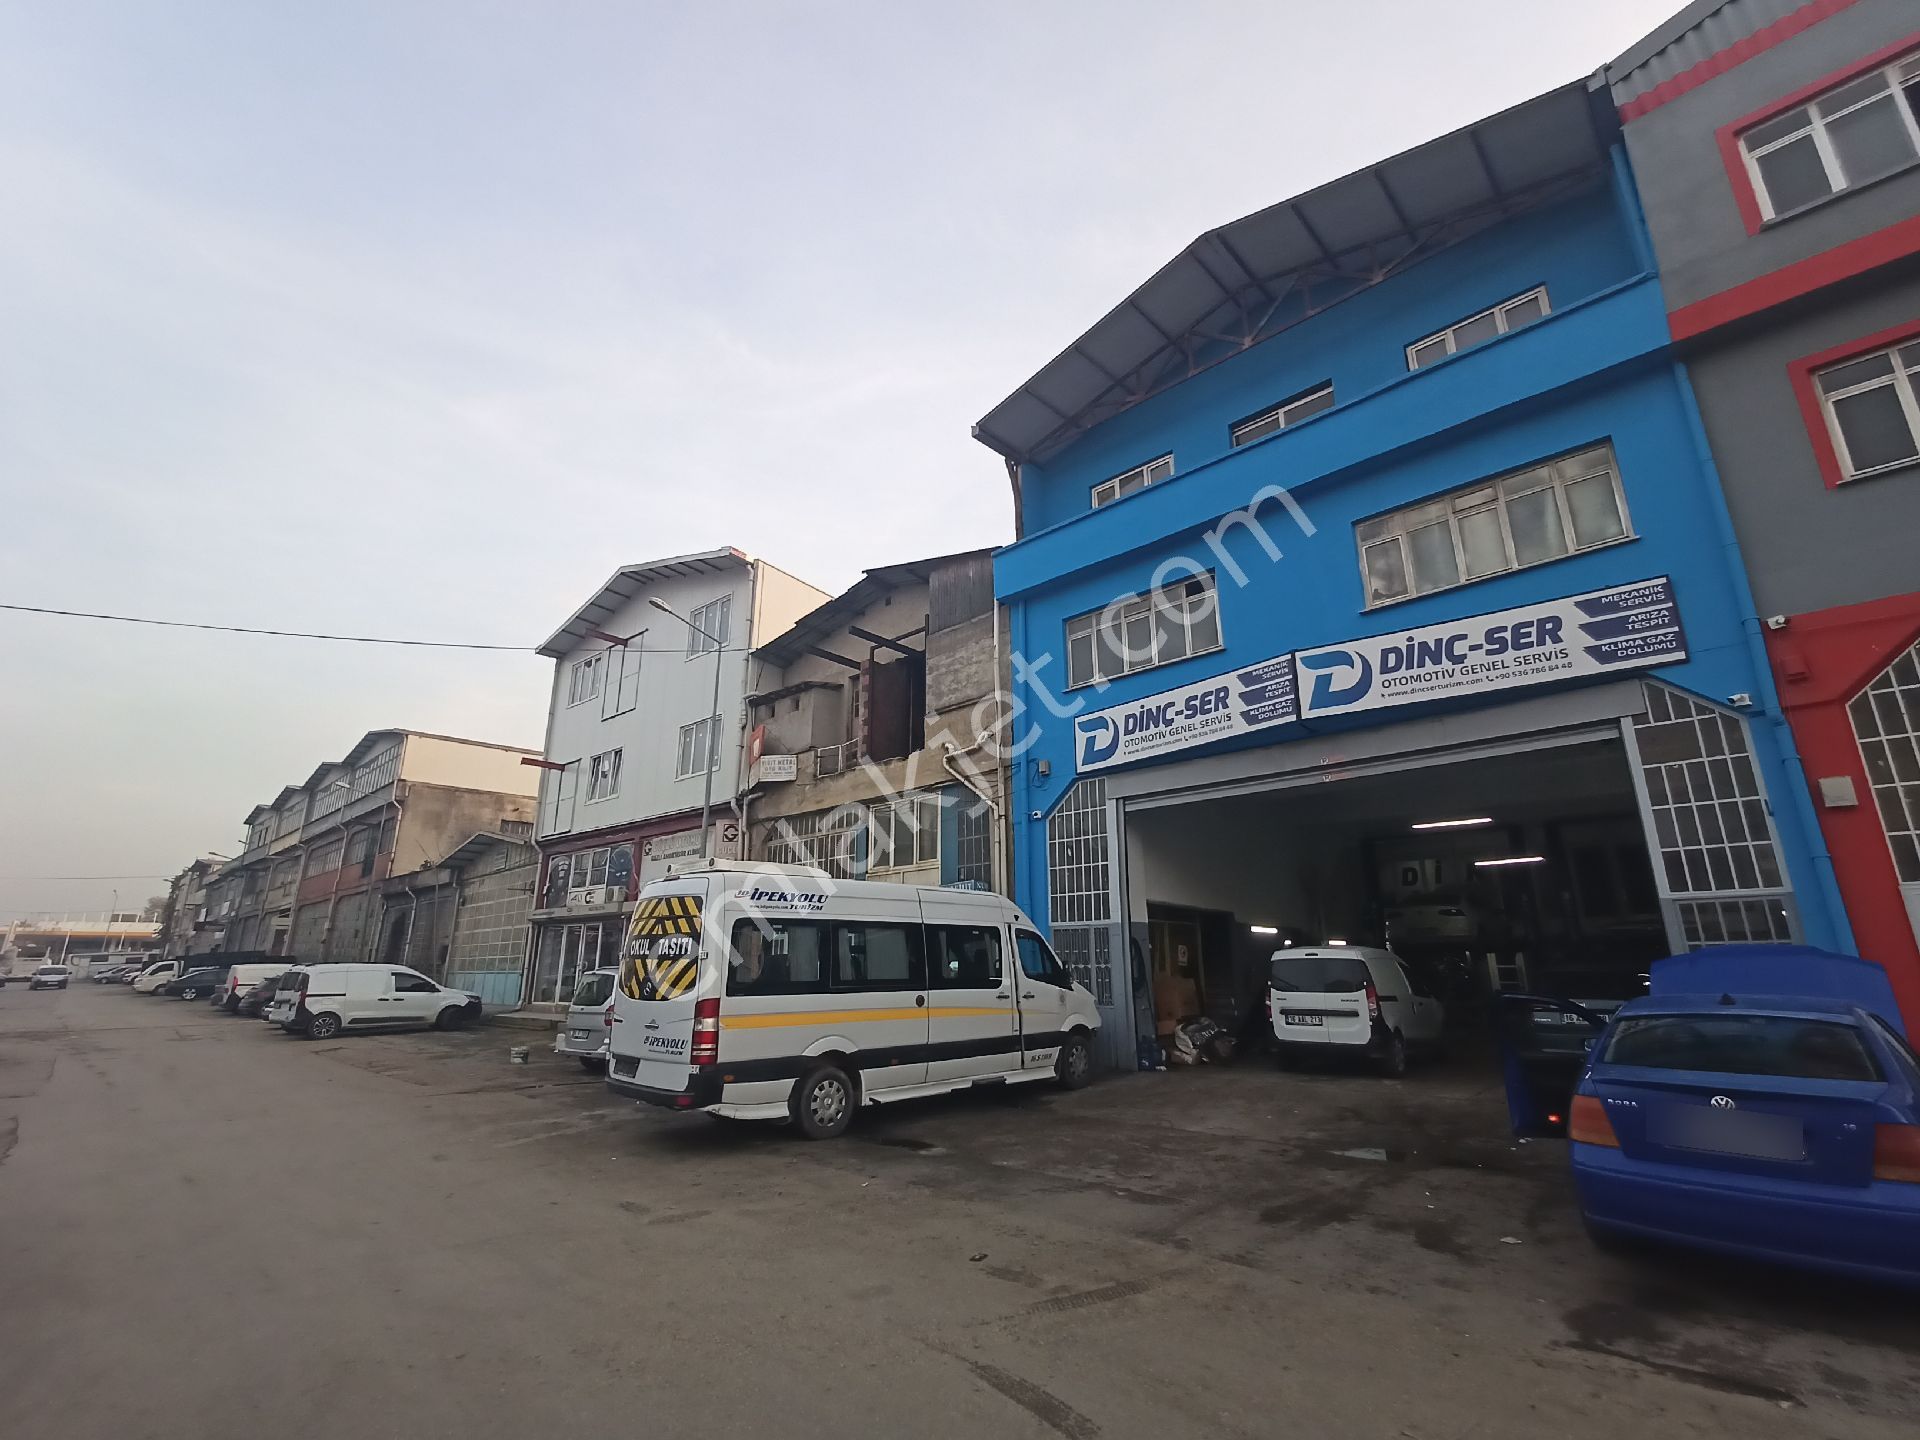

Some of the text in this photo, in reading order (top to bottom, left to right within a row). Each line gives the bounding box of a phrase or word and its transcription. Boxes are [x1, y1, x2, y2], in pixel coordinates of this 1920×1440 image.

[1601, 585, 1664, 604] MEKANİK
[1619, 592, 1665, 608] SERVİS
[1625, 616, 1671, 631] TESPİT
[1628, 609, 1669, 623] ARIZA
[1379, 616, 1563, 675] DİNÇ-SER
[1601, 633, 1676, 652] KLİMA GAZ
[1617, 641, 1676, 657] DOLUMU
[1252, 661, 1288, 676] MEKANİK
[1382, 648, 1569, 688] OTOMOTİV GENEL SERVİS
[1388, 677, 1483, 697] www.dincserturizm.com
[1123, 685, 1230, 736] DİNÇ-SER
[1124, 712, 1232, 748] OTOMOTİV GENEL SERVİS
[751, 888, 828, 904] İPEKYOLU
[631, 938, 693, 957] OKUL TAŞITI
